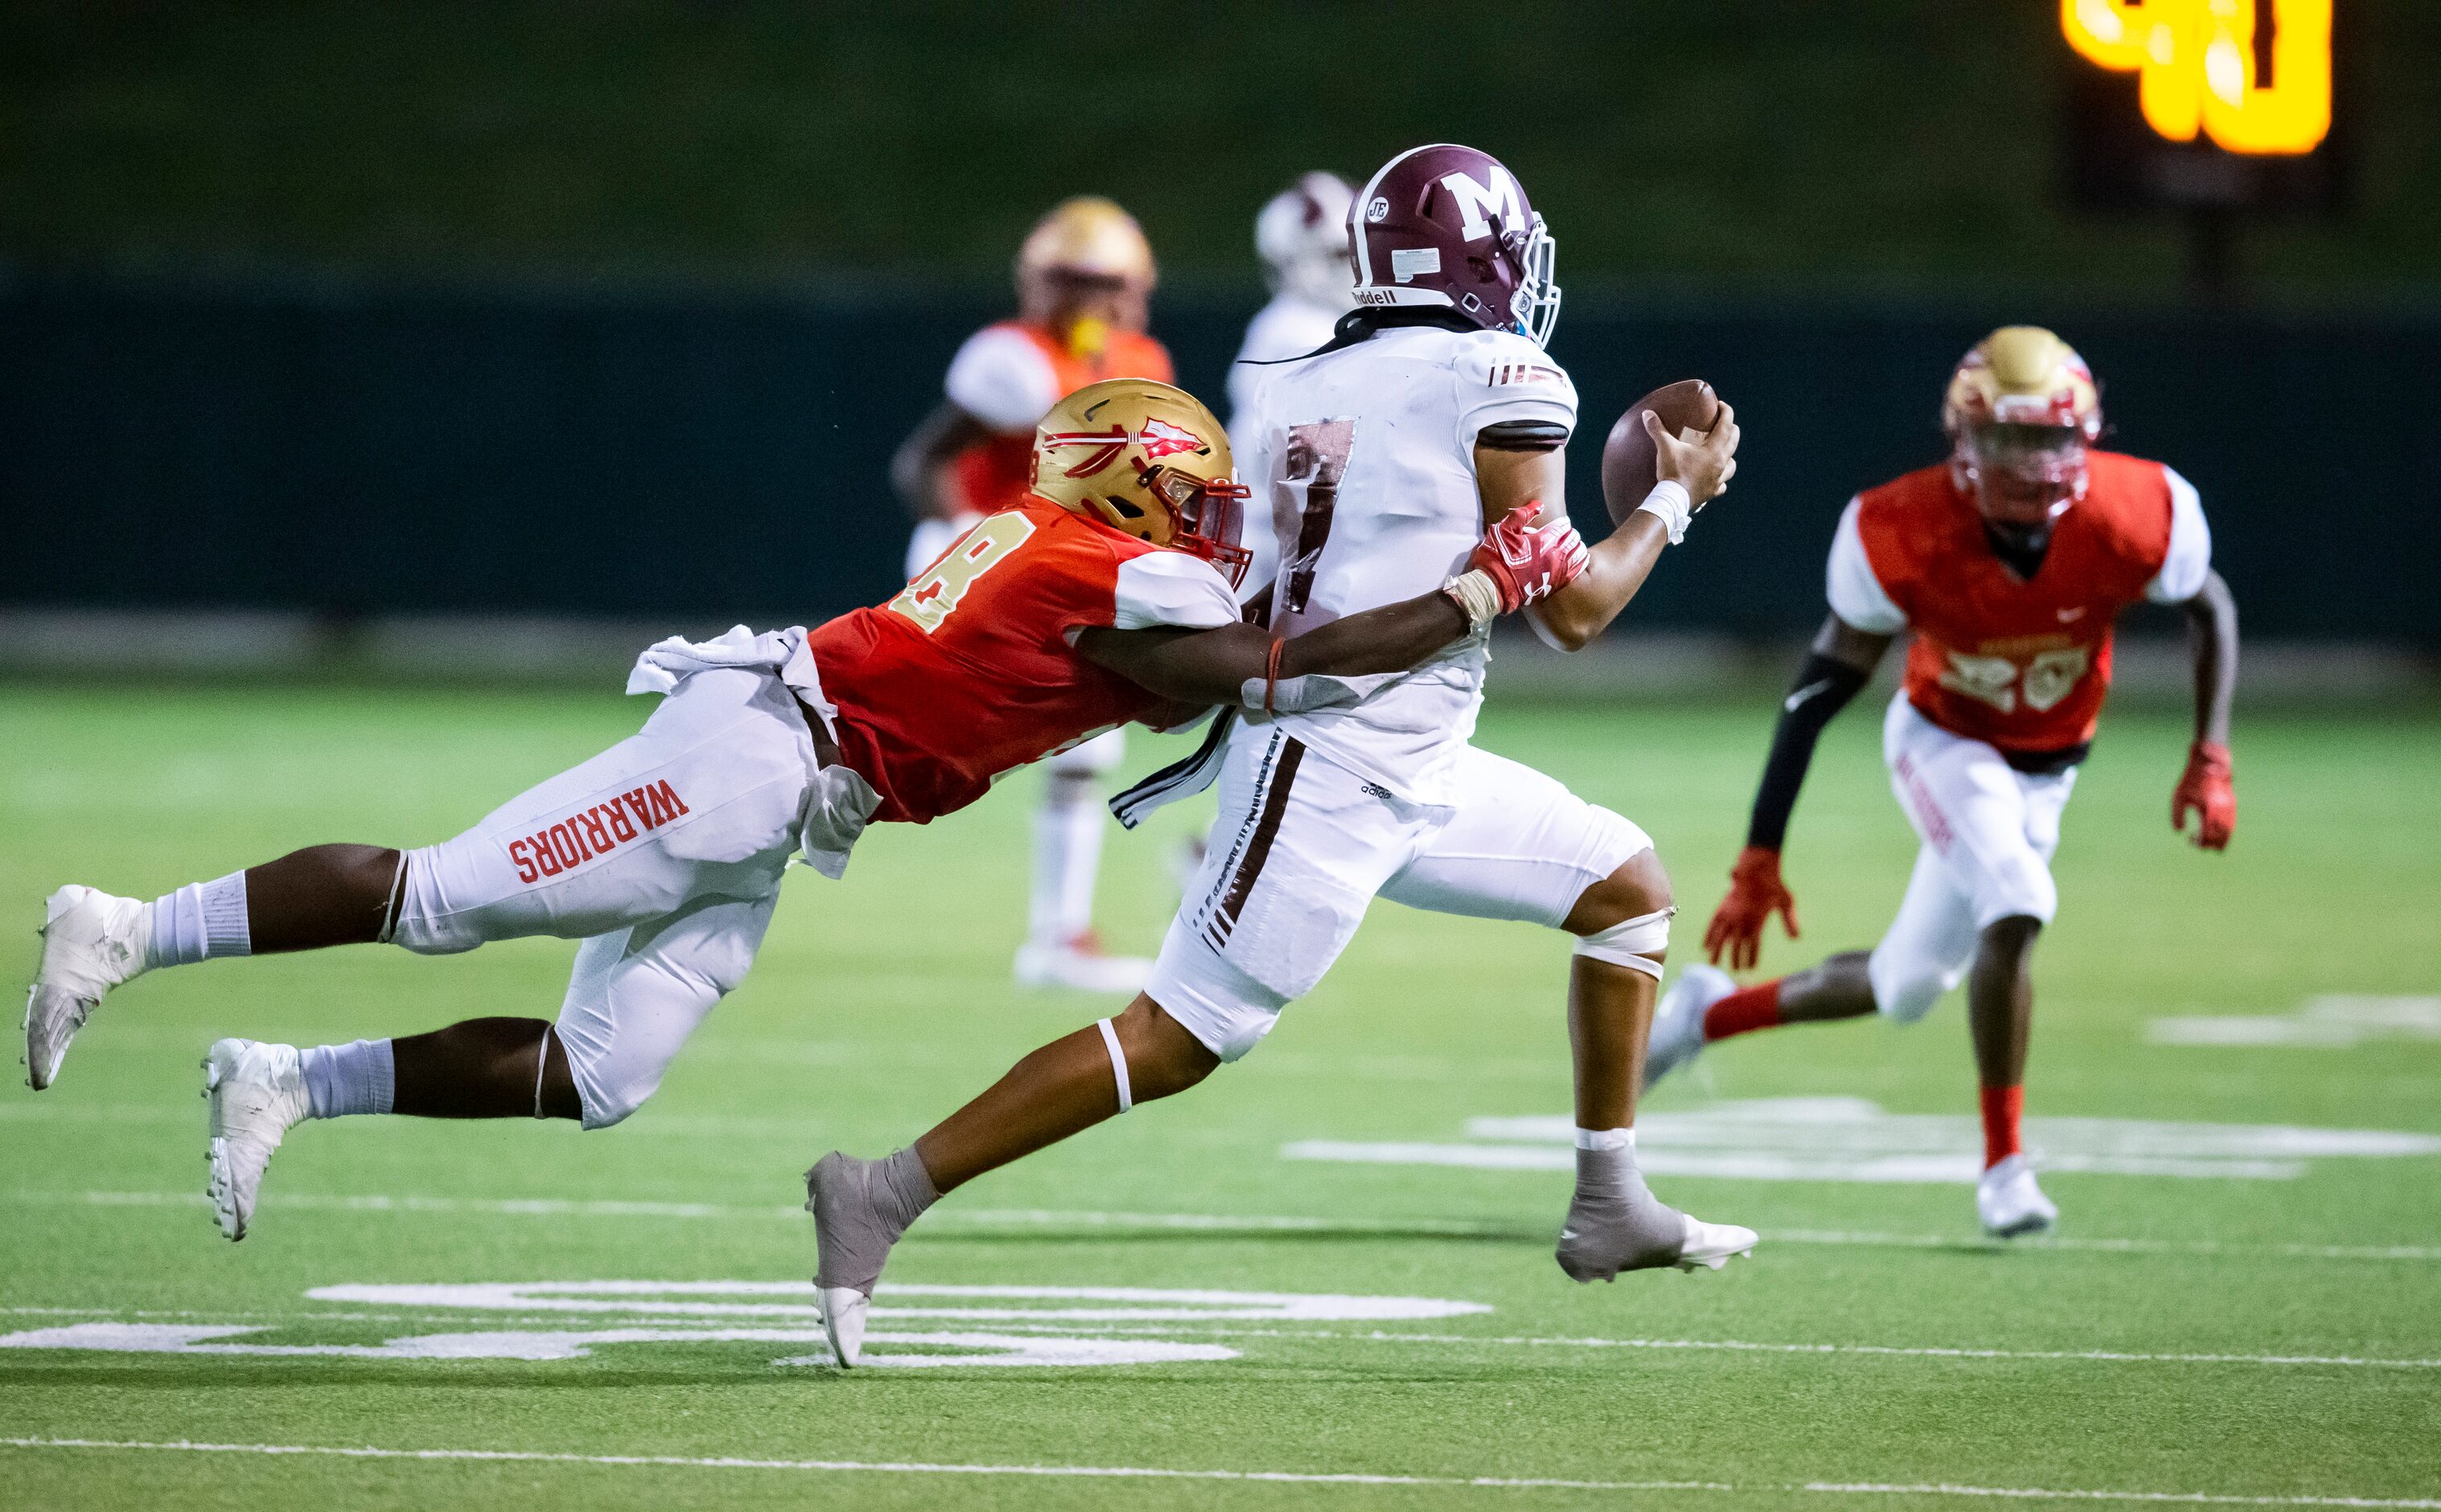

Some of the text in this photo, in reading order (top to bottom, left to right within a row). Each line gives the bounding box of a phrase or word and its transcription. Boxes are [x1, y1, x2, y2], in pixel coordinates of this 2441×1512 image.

[1369, 201, 1387, 218] JE
[1439, 165, 1526, 242] M
[1361, 785, 1393, 799] adidas
[509, 779, 690, 884] WARRIORS
